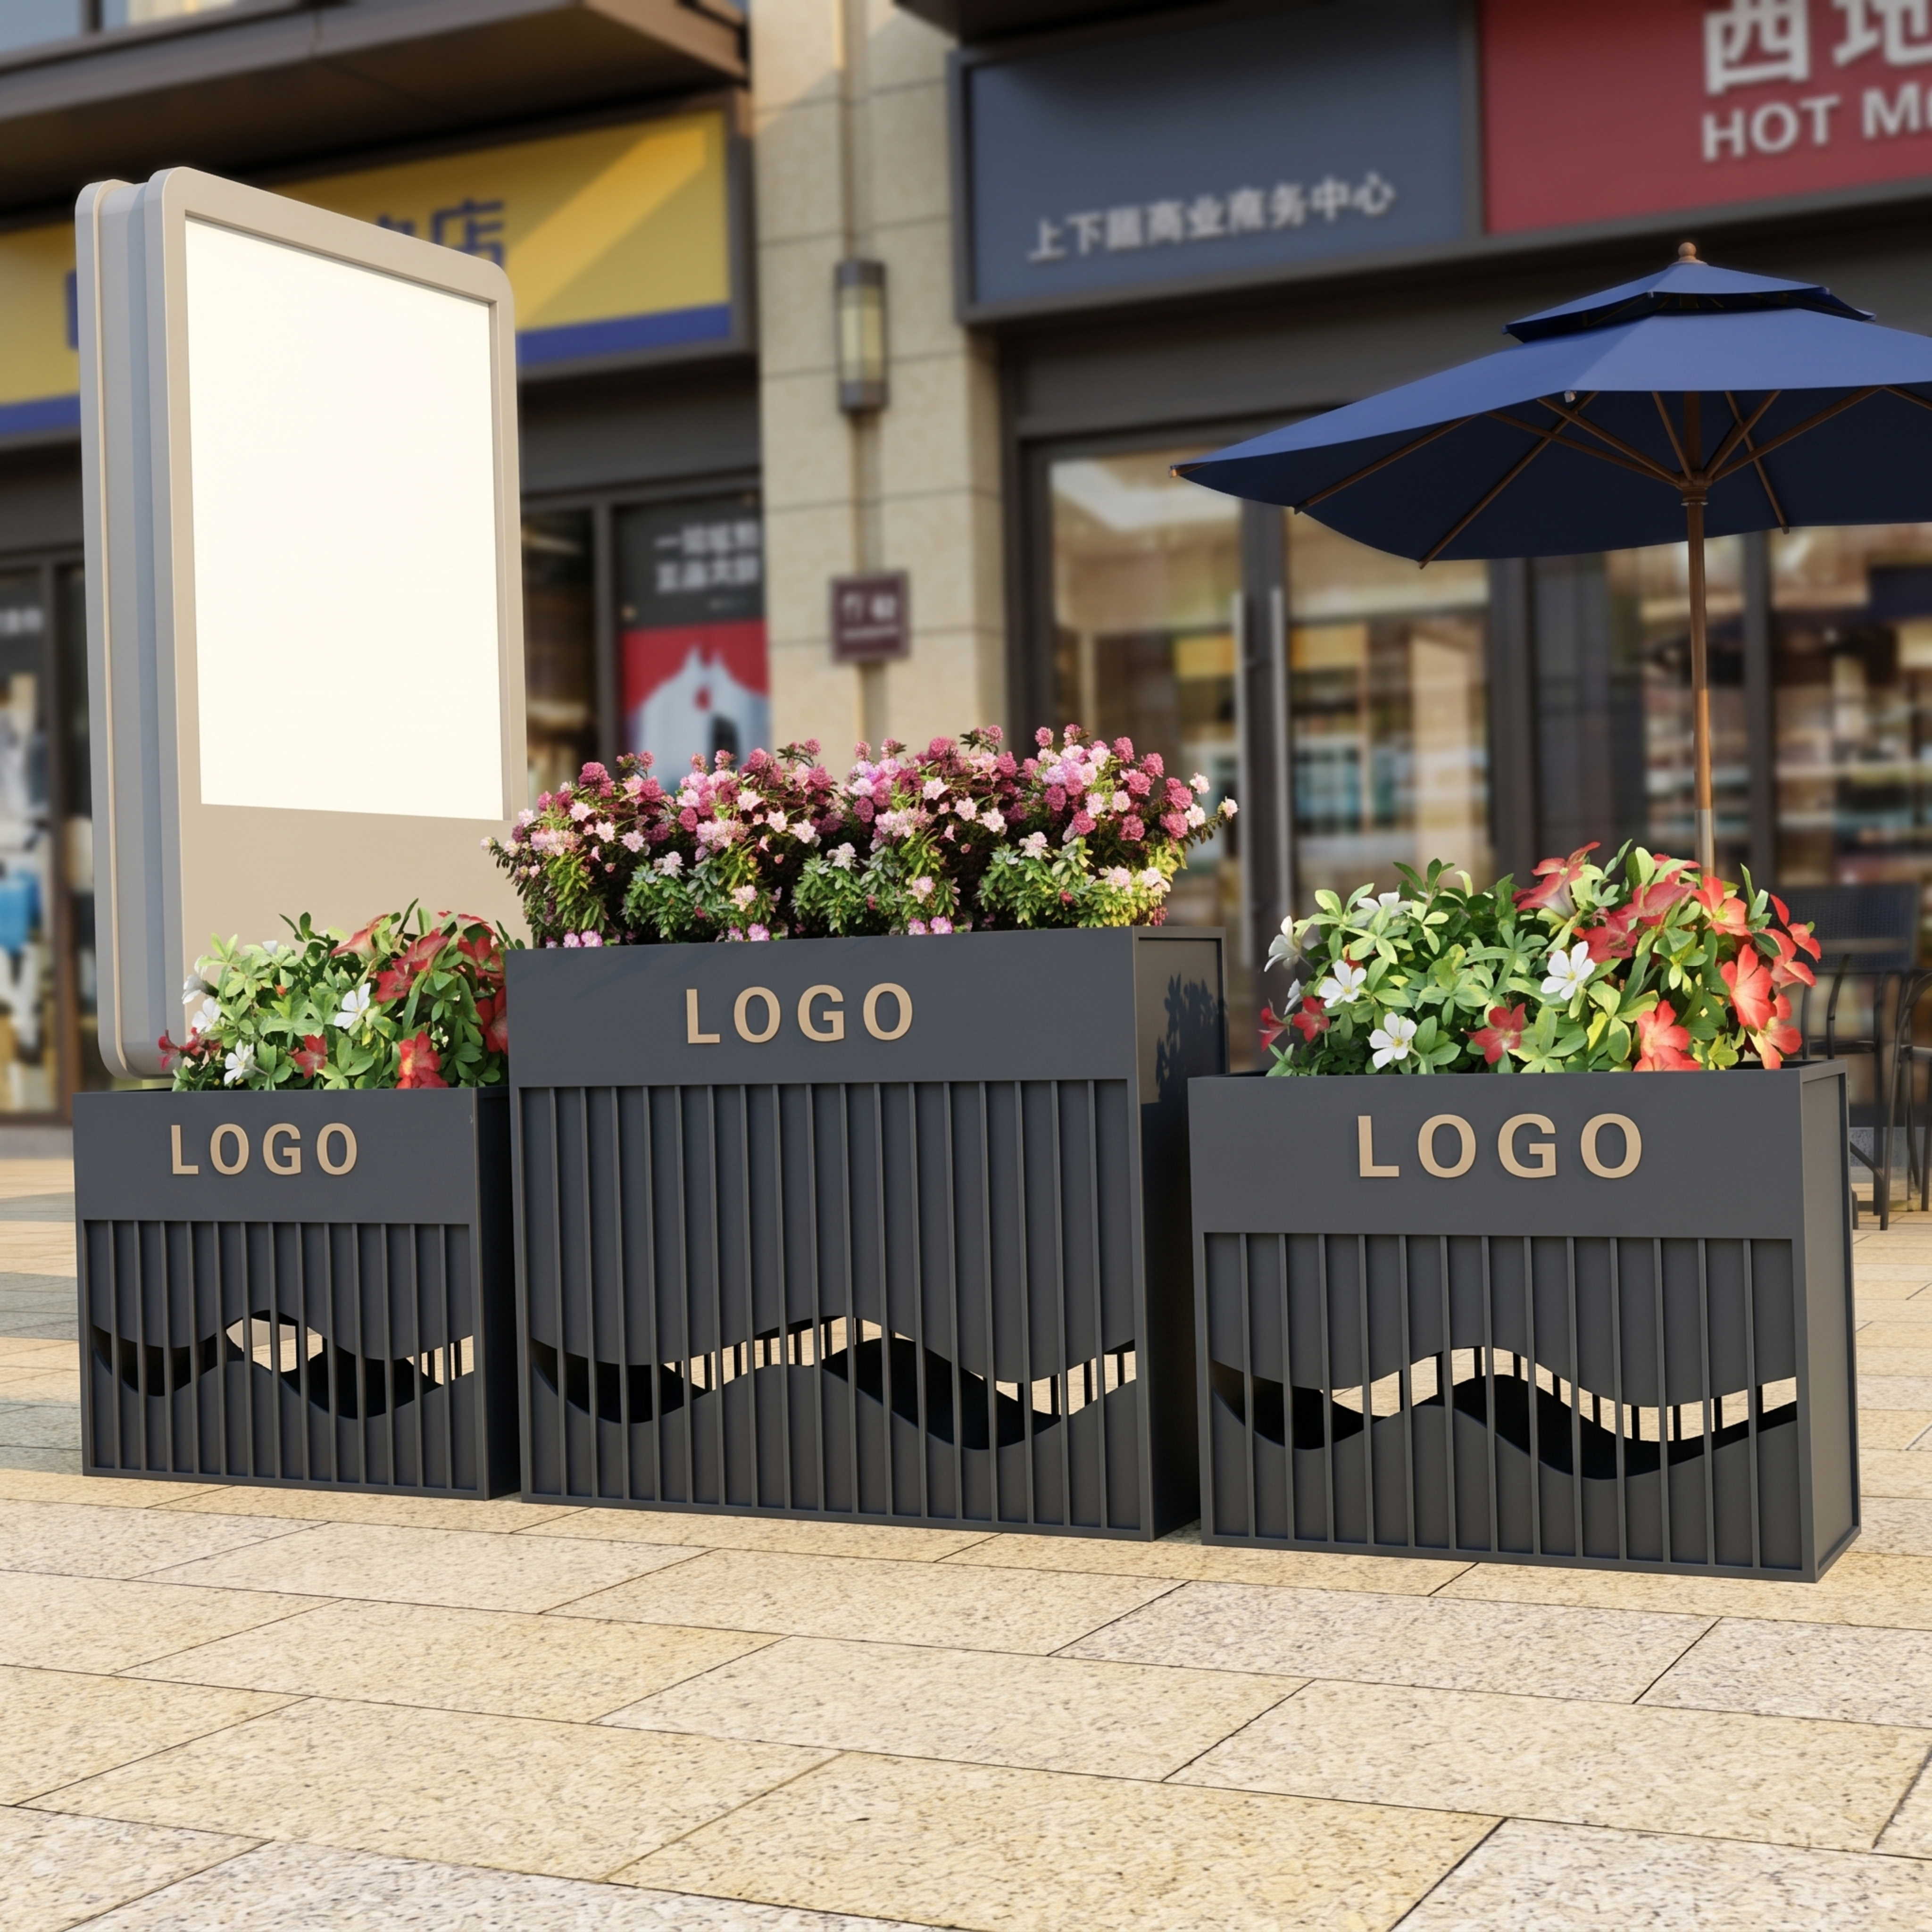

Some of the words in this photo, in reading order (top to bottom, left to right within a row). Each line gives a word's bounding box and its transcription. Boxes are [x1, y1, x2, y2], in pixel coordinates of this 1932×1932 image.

[1702, 94, 1840, 162] HOT
[1863, 82, 1932, 139] M
[686, 983, 913, 1044] LOGO
[171, 1123, 358, 1175] LOGO
[1358, 1113, 1642, 1179] LOGO
